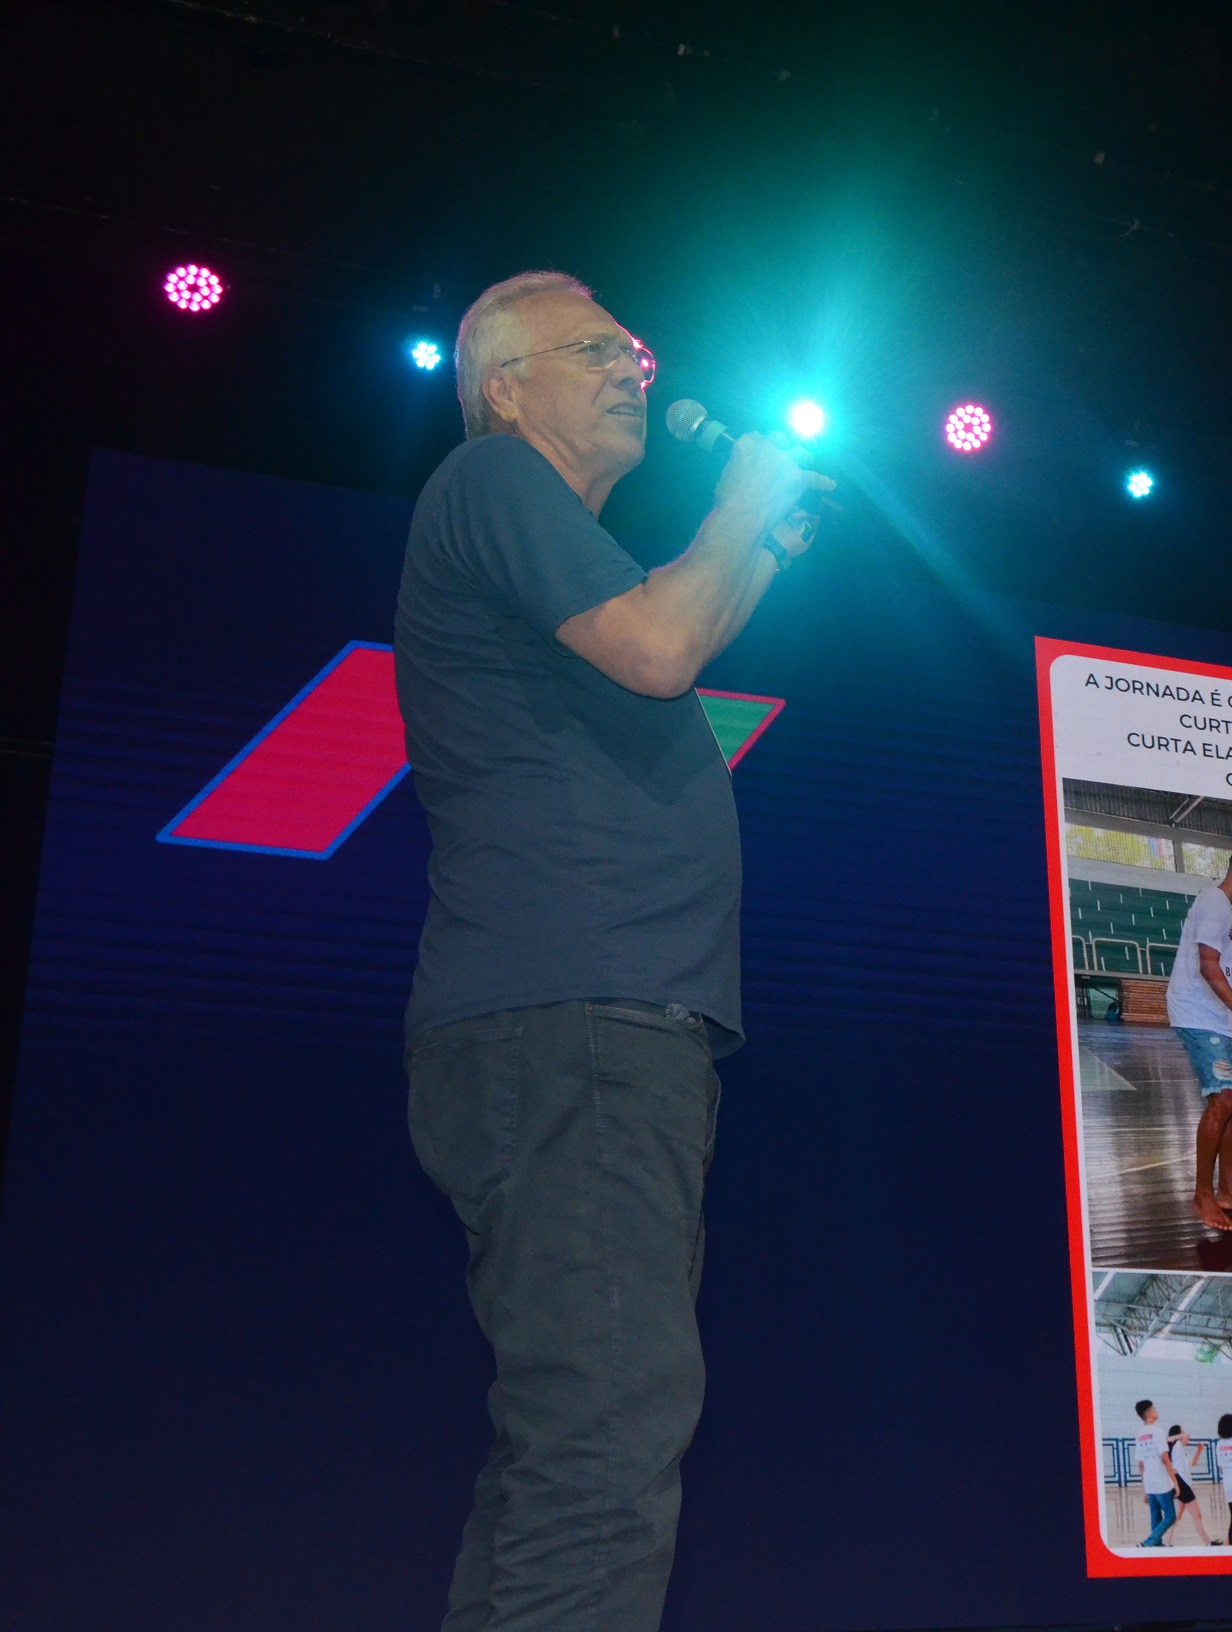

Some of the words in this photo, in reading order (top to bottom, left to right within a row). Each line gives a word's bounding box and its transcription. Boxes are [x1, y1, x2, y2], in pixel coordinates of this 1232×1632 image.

[1085, 673, 1100, 689] A
[1104, 675, 1206, 706] JORNADA
[1210, 689, 1222, 708] É
[1126, 732, 1197, 757] CURTA
